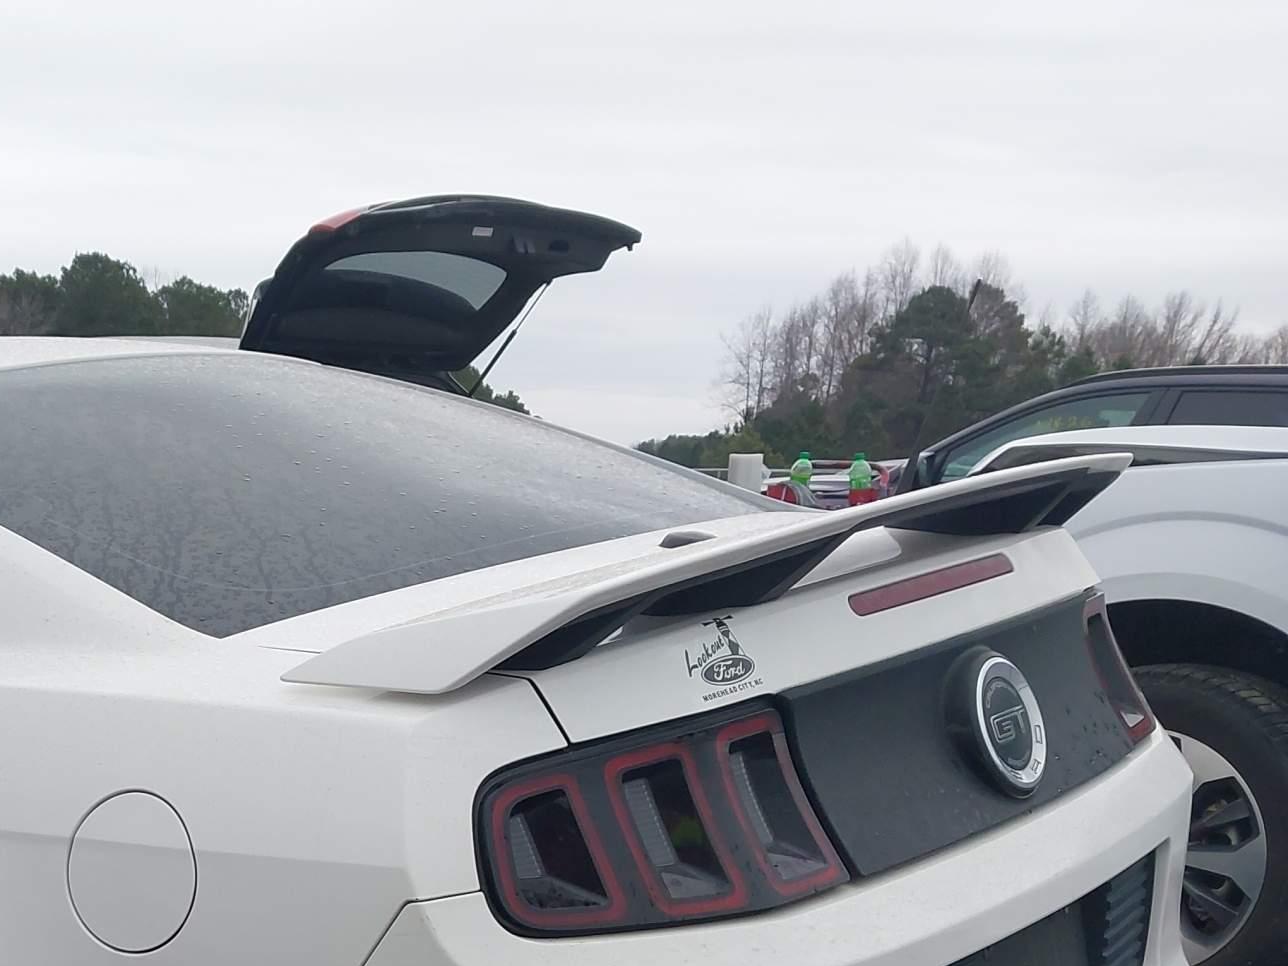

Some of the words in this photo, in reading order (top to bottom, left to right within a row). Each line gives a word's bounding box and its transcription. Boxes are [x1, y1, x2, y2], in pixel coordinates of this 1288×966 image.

[684, 634, 724, 678] Lookout
[713, 660, 746, 681] Ford
[702, 686, 738, 702] MOREHEAD
[990, 704, 1025, 744] GT
